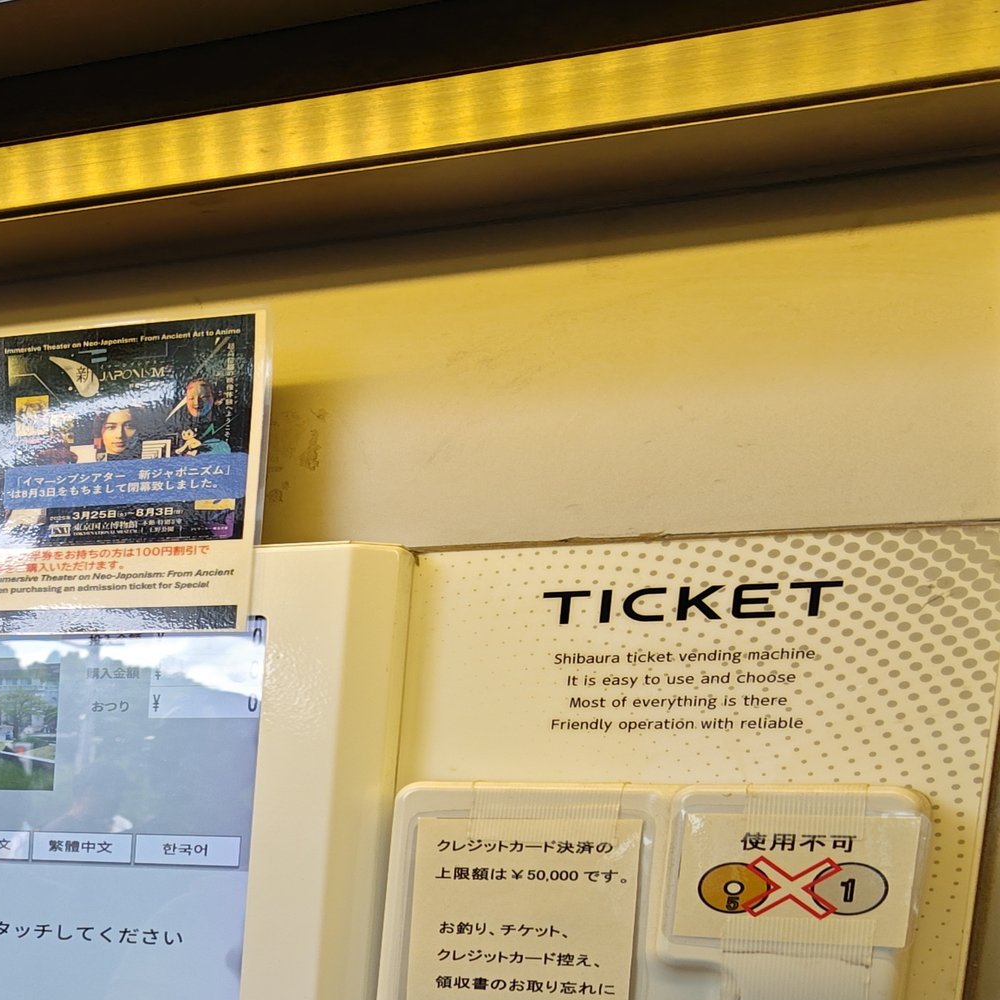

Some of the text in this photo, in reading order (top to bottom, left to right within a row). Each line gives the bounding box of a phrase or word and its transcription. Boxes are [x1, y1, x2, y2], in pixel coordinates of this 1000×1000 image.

[4, 346, 41, 354] Immersive
[43, 342, 70, 351] Theater
[84, 338, 138, 347] Neo-Japonism:
[161, 332, 191, 340] Ancient
[41, 574, 77, 582] Theater
[92, 571, 164, 581] Neo-Japonism:
[167, 570, 192, 578] From
[195, 568, 234, 577] Ancient
[11, 585, 62, 594] purchasing
[78, 583, 127, 591] admission
[129, 582, 156, 590] ticket
[174, 581, 209, 589] Special
[543, 580, 844, 625] TICKET
[553, 648, 816, 665] Shibaura ticket vending machine
[87, 667, 140, 679] 購入金額
[567, 672, 796, 688] It is easy to use and choose
[91, 700, 129, 712] おつり
[569, 695, 788, 710] Most of everything is there
[551, 716, 804, 733] Friendly operation with reliable
[49, 840, 112, 854] 繁體中文
[162, 843, 208, 857] 한국어
[437, 839, 614, 854] クレジットカード決済の
[741, 832, 857, 852] 使用不可
[439, 921, 568, 939] お釣り、チケット、
[437, 949, 600, 968] クレジットカード控え、
[435, 976, 616, 995] 領収書のお取り忘れに
